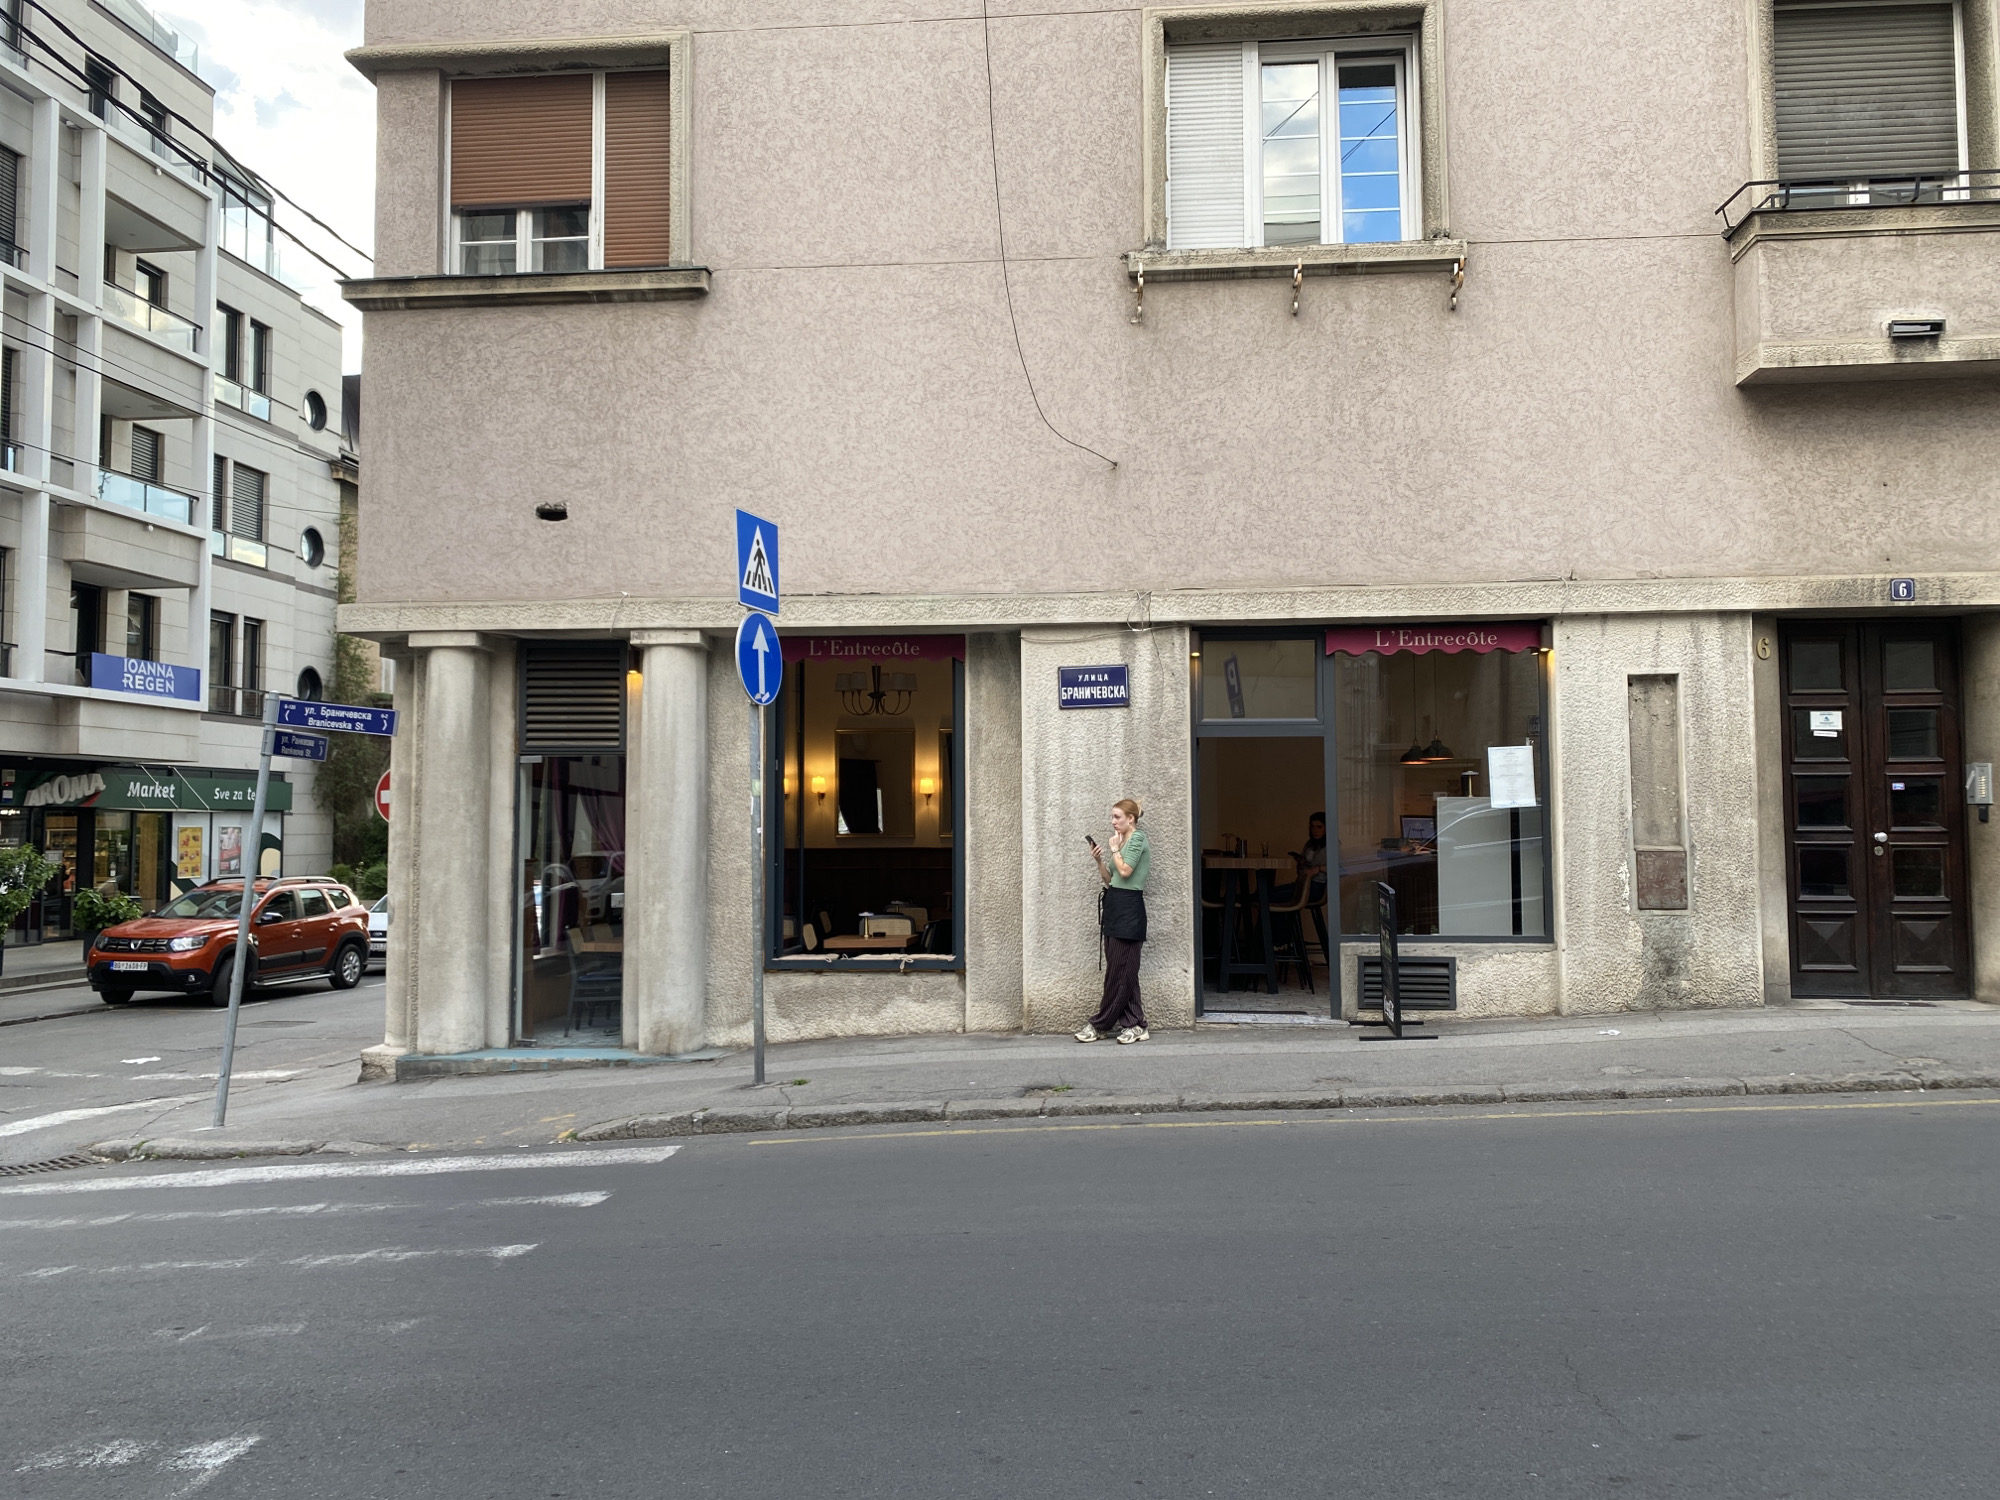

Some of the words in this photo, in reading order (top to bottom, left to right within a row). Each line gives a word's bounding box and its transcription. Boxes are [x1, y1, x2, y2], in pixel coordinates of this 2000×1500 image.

[1899, 582, 1907, 597] 6
[1375, 630, 1498, 647] L'Entrecôte
[809, 639, 920, 655] L'Entrecôte
[1756, 637, 1771, 660] 6
[123, 658, 175, 679] IOANNA
[121, 673, 175, 694] REGEN
[1078, 673, 1109, 682] УЛИЦА
[1061, 685, 1126, 700] БРАНИЧЕВСКА
[304, 706, 317, 716] ул.
[321, 706, 372, 720] Браничевска
[308, 717, 352, 729] Branicevska
[355, 721, 366, 731] St.
[24, 773, 106, 806] AROMA
[127, 782, 176, 798] Market
[213, 787, 230, 800] Sve
[232, 790, 243, 800] za
[247, 786, 256, 801] te
